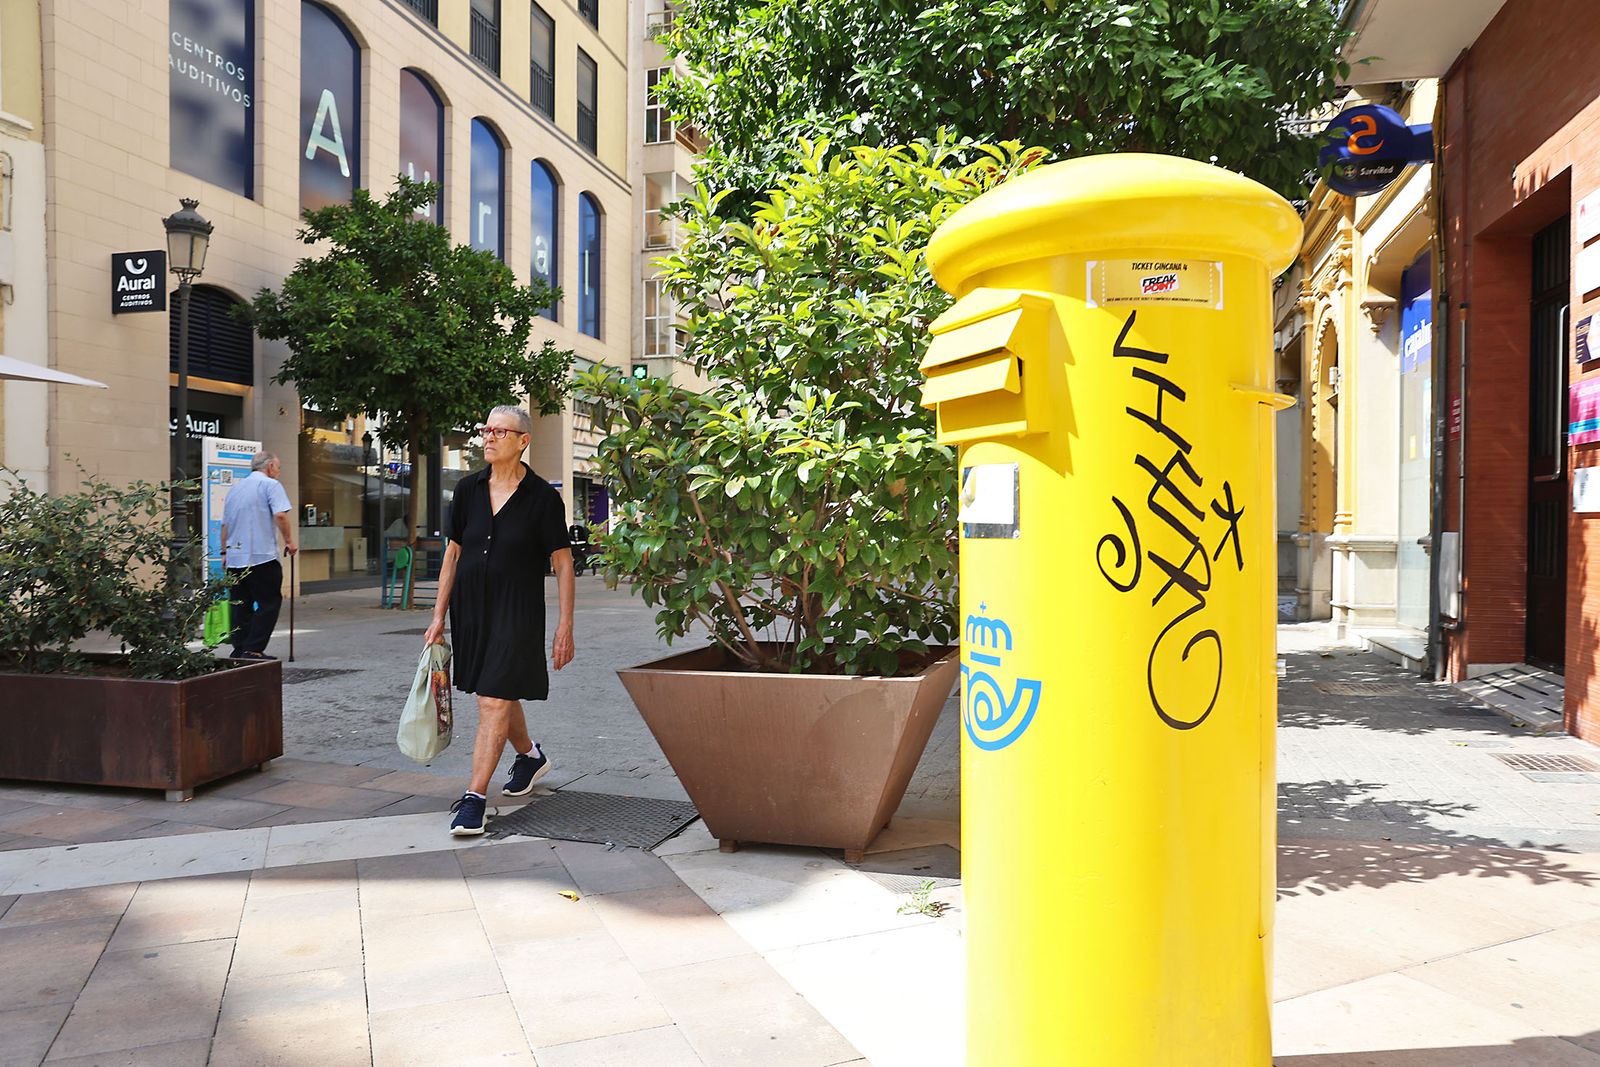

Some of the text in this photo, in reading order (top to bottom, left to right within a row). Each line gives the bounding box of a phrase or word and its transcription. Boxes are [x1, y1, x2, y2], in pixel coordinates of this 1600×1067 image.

[172, 32, 245, 81] CENTROS
[1131, 262, 1153, 270] TICKET
[117, 274, 156, 292] Aural
[1142, 274, 1177, 287] FREAK
[1143, 279, 1176, 293] POINT
[185, 413, 220, 435] Aural
[215, 442, 257, 453] HUELVA CENTRO
